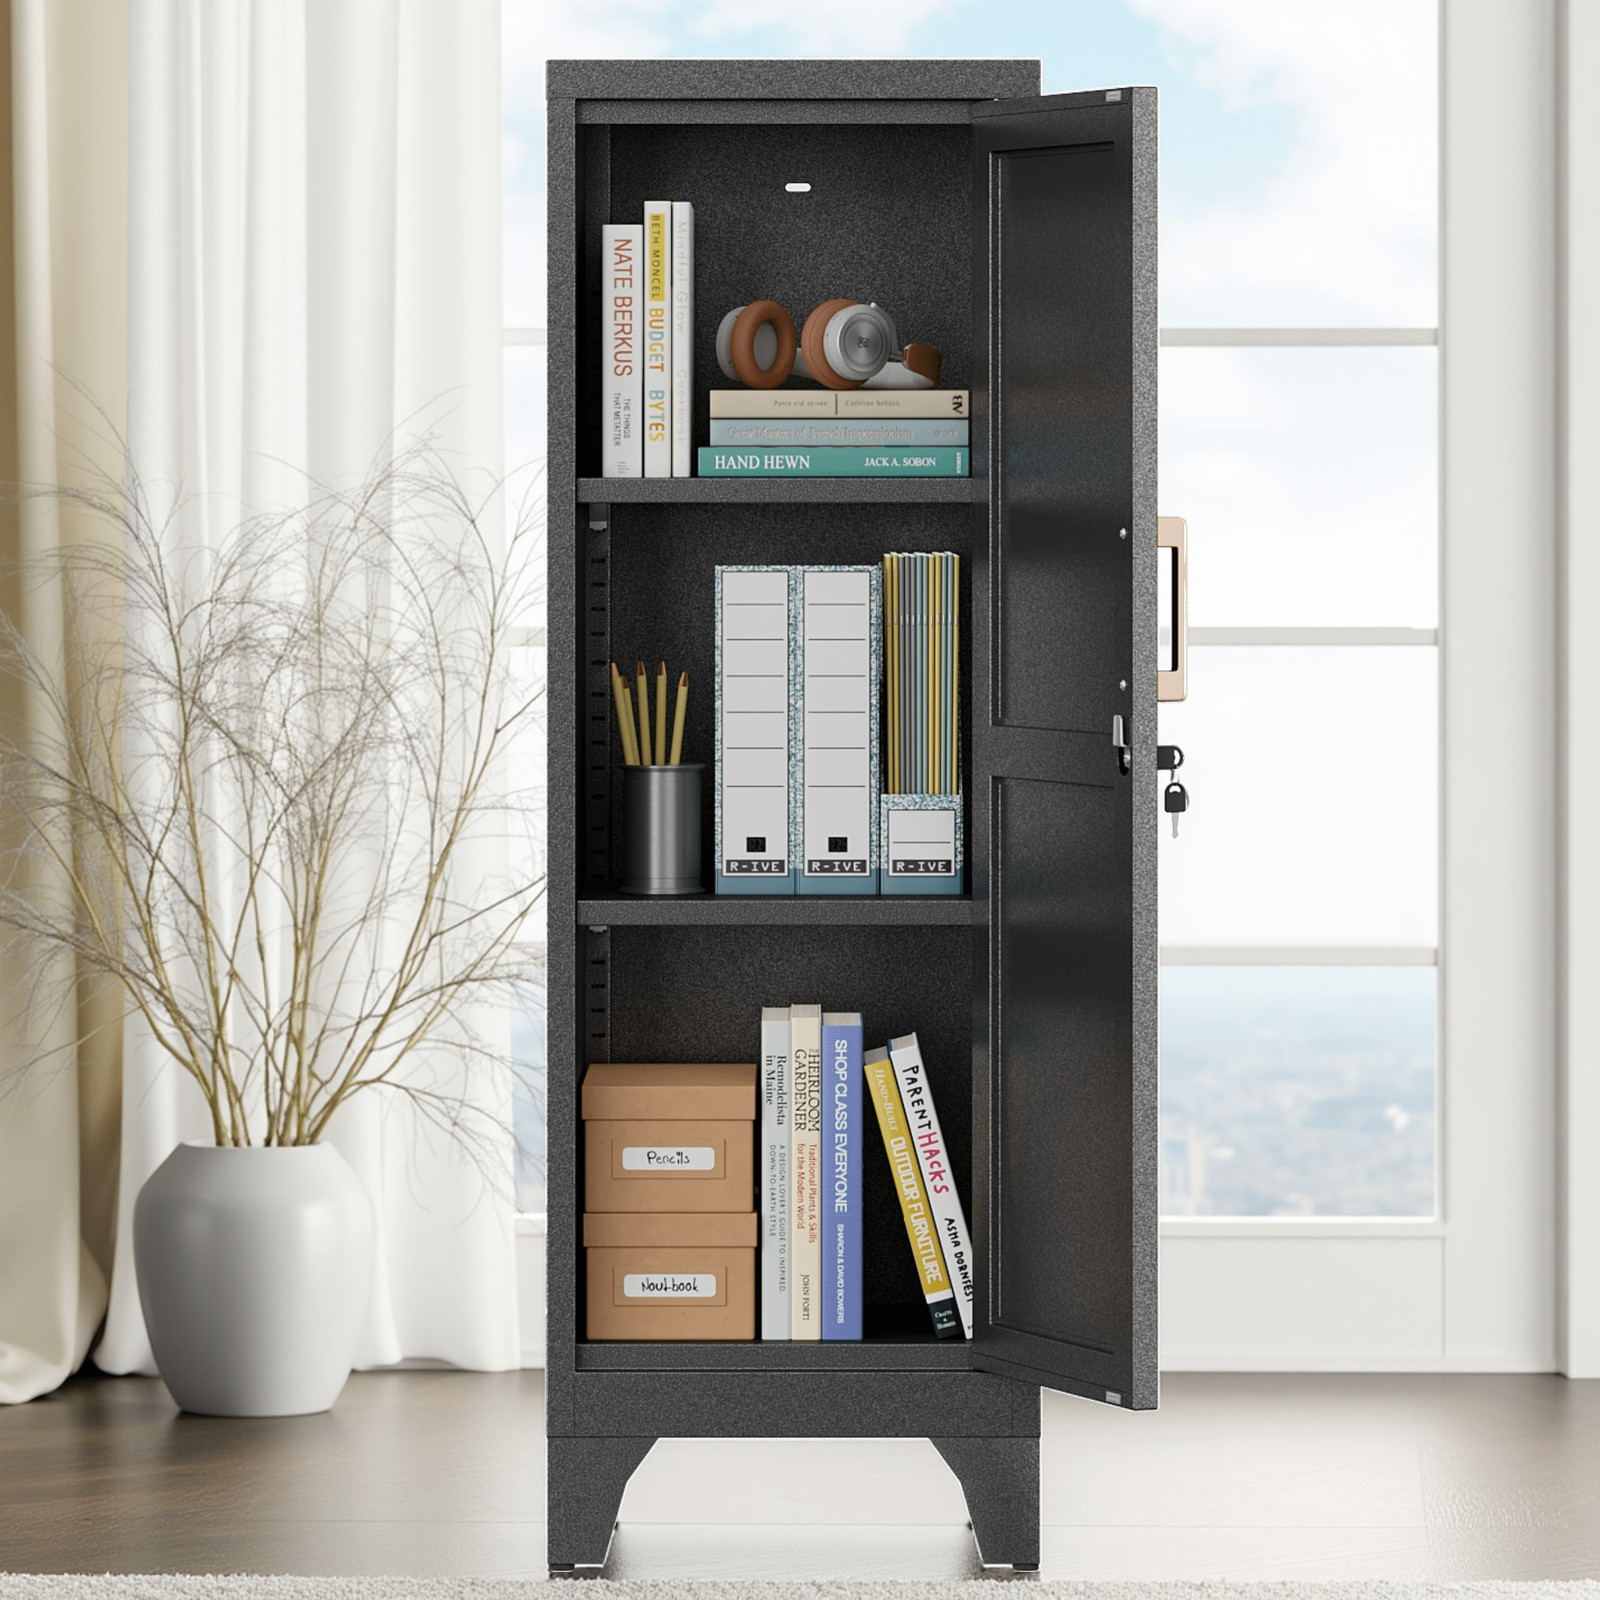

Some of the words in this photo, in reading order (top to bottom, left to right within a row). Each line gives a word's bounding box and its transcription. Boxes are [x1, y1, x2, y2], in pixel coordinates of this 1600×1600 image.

[652, 215, 660, 243] BETH
[613, 239, 633, 288] NATE
[676, 221, 688, 281] Mindful
[652, 250, 660, 298] MONCEL
[676, 291, 688, 333] Glow
[613, 296, 633, 376] BERKUS
[649, 308, 665, 372] BUDGET
[613, 392, 621, 409] THAT
[623, 398, 631, 411] THE
[623, 413, 631, 439] THINGS
[649, 390, 665, 442] BYTES
[795, 426, 807, 439] of
[810, 426, 841, 439] French
[844, 426, 912, 441] Impressionism
[715, 455, 760, 469] HAND
[763, 455, 810, 469] HEWN
[864, 457, 889, 467] JACK
[891, 457, 900, 467] A.
[902, 457, 936, 467] SOBON
[730, 861, 780, 872] R-IVE
[811, 861, 862, 872] R-IVE
[896, 861, 947, 872] R-IVE
[766, 1055, 776, 1066] in
[835, 1040, 847, 1081] SHOP
[766, 1070, 776, 1105] Maine
[777, 1055, 787, 1125] Remodelista
[795, 1049, 807, 1131] GARDENER
[808, 1054, 820, 1132] HEIRLOOM
[835, 1083, 847, 1130] CLASS
[646, 1151, 690, 1165] Pencils
[797, 1143, 805, 1154] for
[797, 1157, 805, 1170] the
[809, 1144, 817, 1186] Traditional
[835, 1133, 847, 1213] EVERYONE
[797, 1172, 805, 1203] Modern
[809, 1188, 817, 1212] Plants
[797, 1206, 805, 1229] World
[890, 1136, 919, 1201] OUTDOOR
[908, 1201, 943, 1285] FURNITURE
[809, 1222, 817, 1243] Skills
[944, 1217, 961, 1248] ASHA
[779, 1243, 786, 1254] TO
[801, 1274, 809, 1295] JOHN
